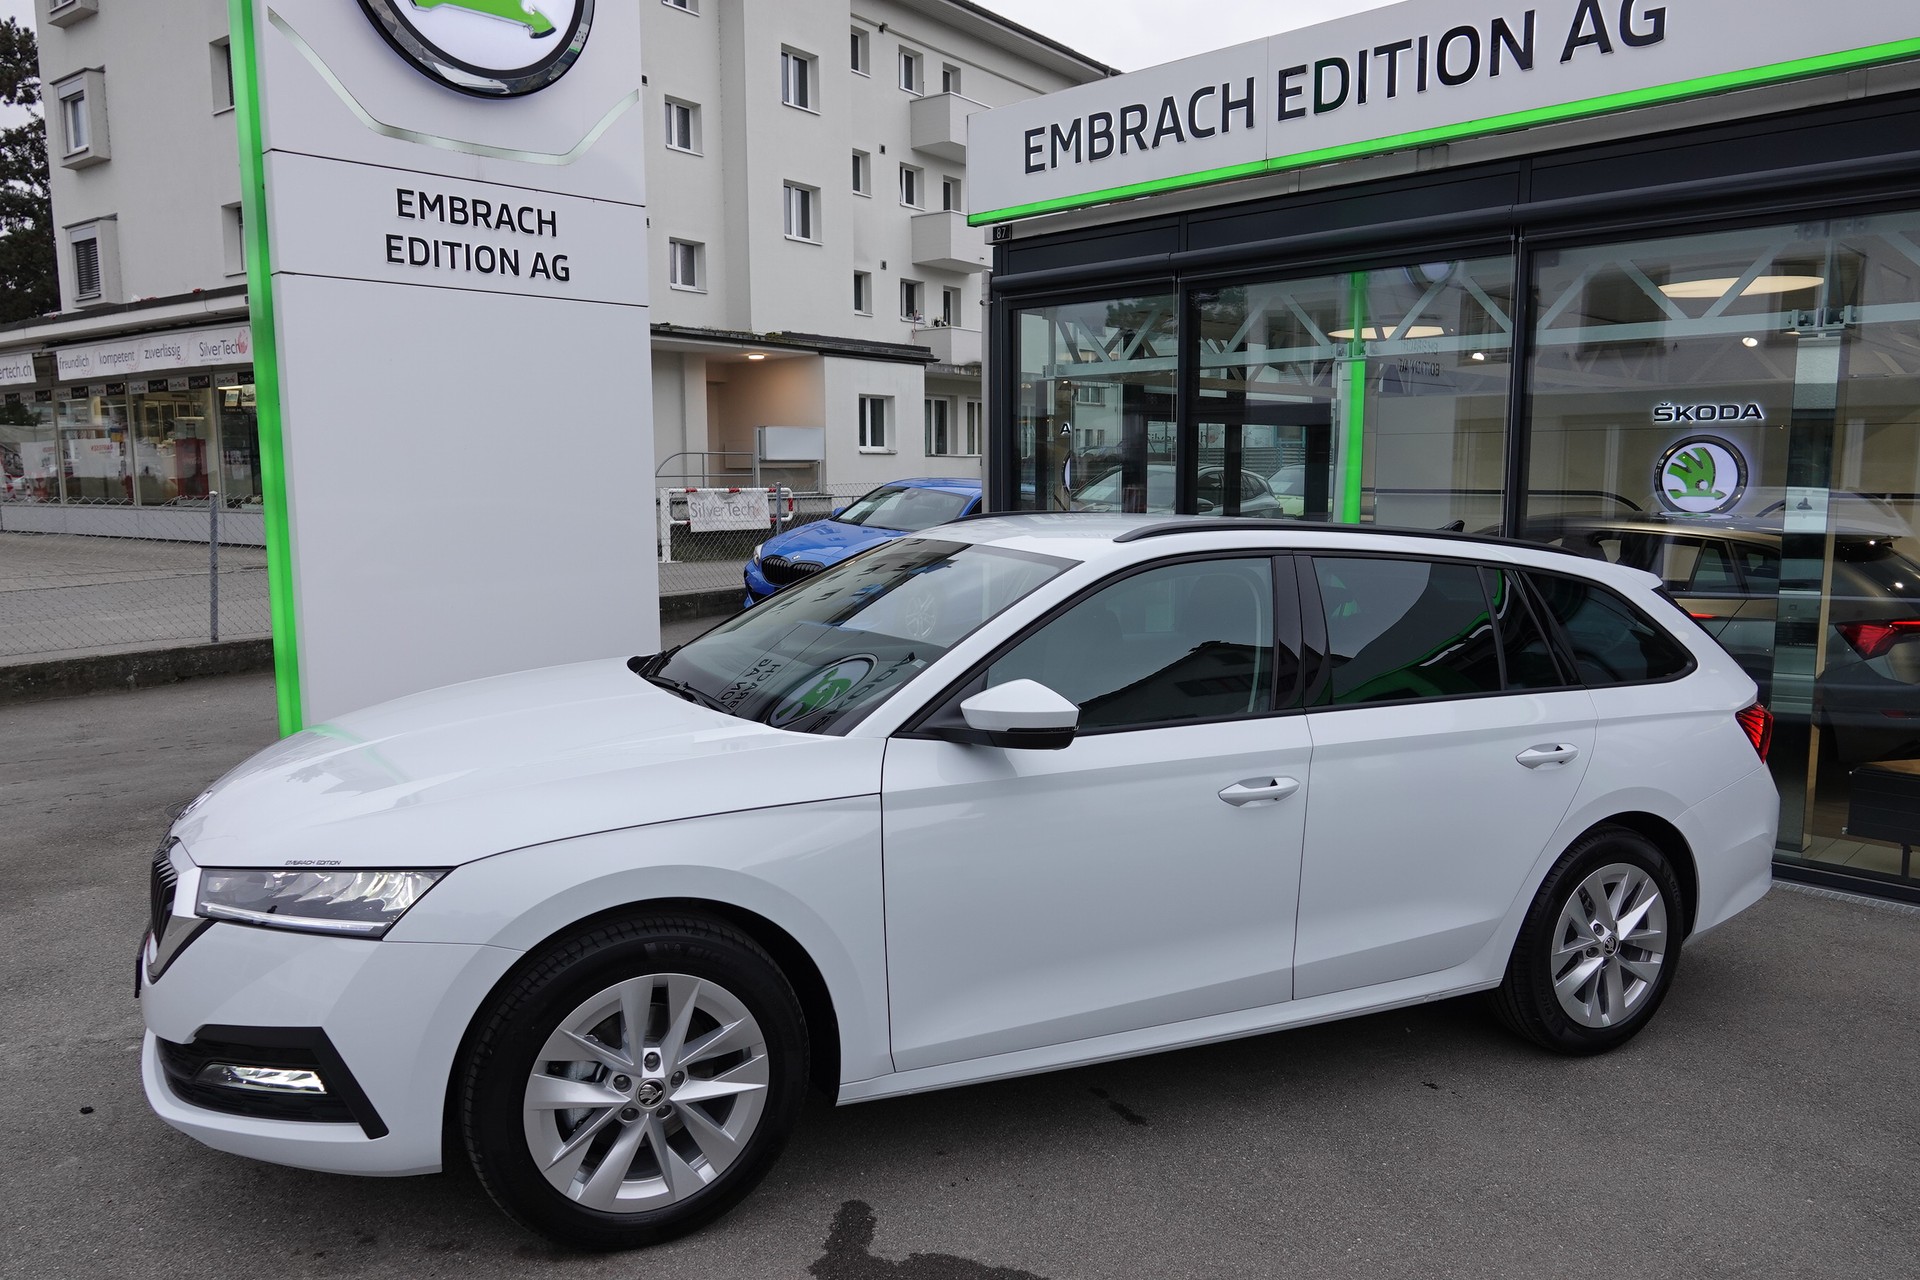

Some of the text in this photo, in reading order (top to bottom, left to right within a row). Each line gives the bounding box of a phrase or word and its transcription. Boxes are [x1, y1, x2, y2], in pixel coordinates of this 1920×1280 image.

[1024, 0, 1666, 175] EMBRACH EDITION AG
[396, 188, 557, 238] EMBRACH
[996, 227, 1006, 239] 87
[385, 233, 570, 282] EDITION AG
[59, 354, 90, 370] freundlich
[99, 351, 135, 366] kompetent
[1653, 403, 1763, 422] ŠKODA
[690, 501, 756, 519] SilverTech
